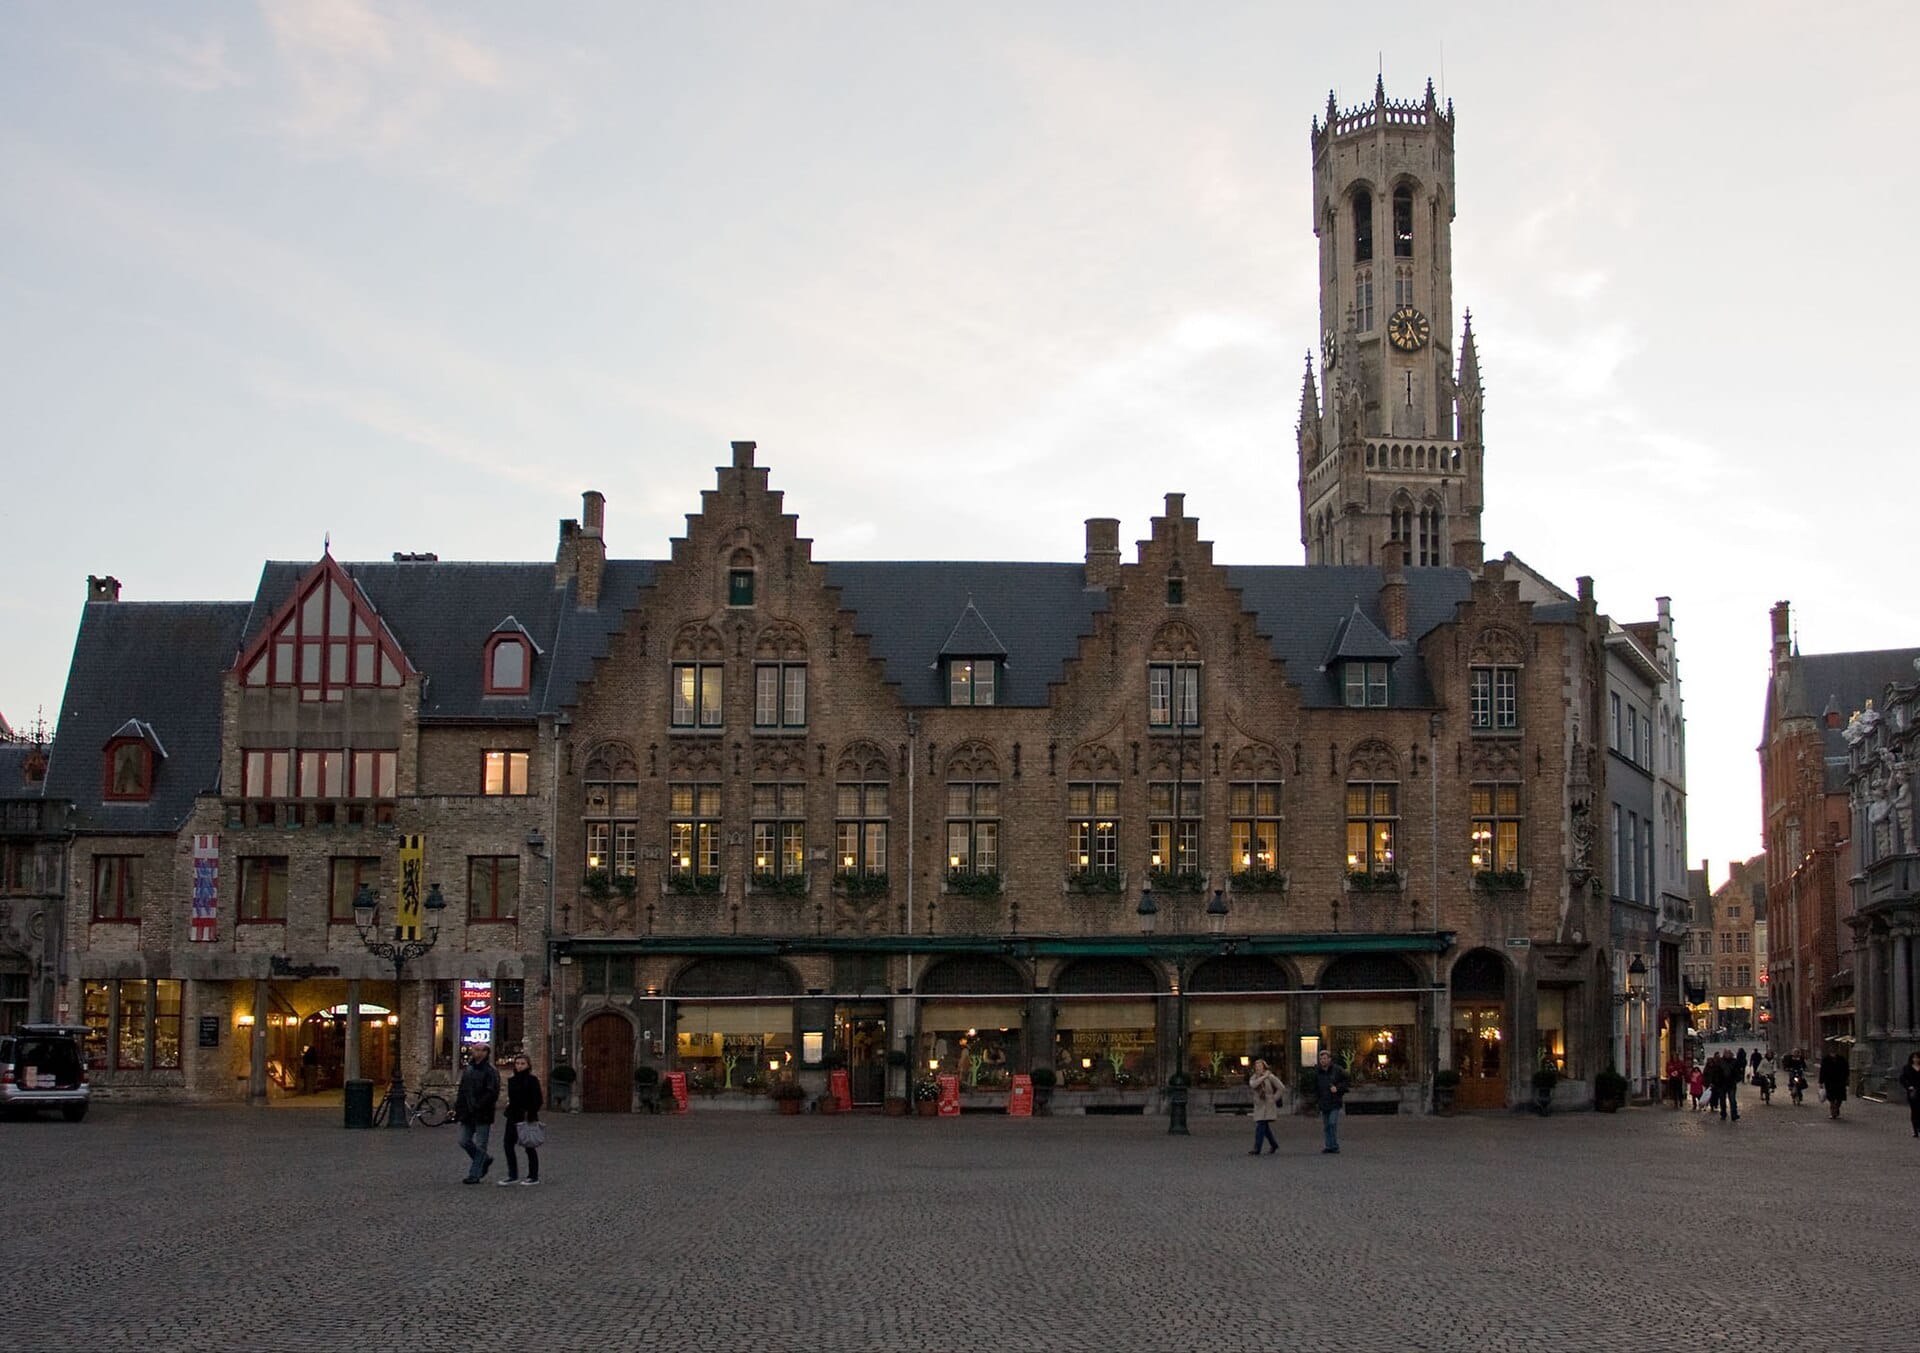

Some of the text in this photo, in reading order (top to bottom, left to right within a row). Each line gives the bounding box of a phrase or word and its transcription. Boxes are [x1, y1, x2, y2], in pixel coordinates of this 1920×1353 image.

[470, 999, 486, 1007] Art
[701, 1036, 768, 1047] RETAURAN
[1073, 1032, 1138, 1044] RESTAURANT
